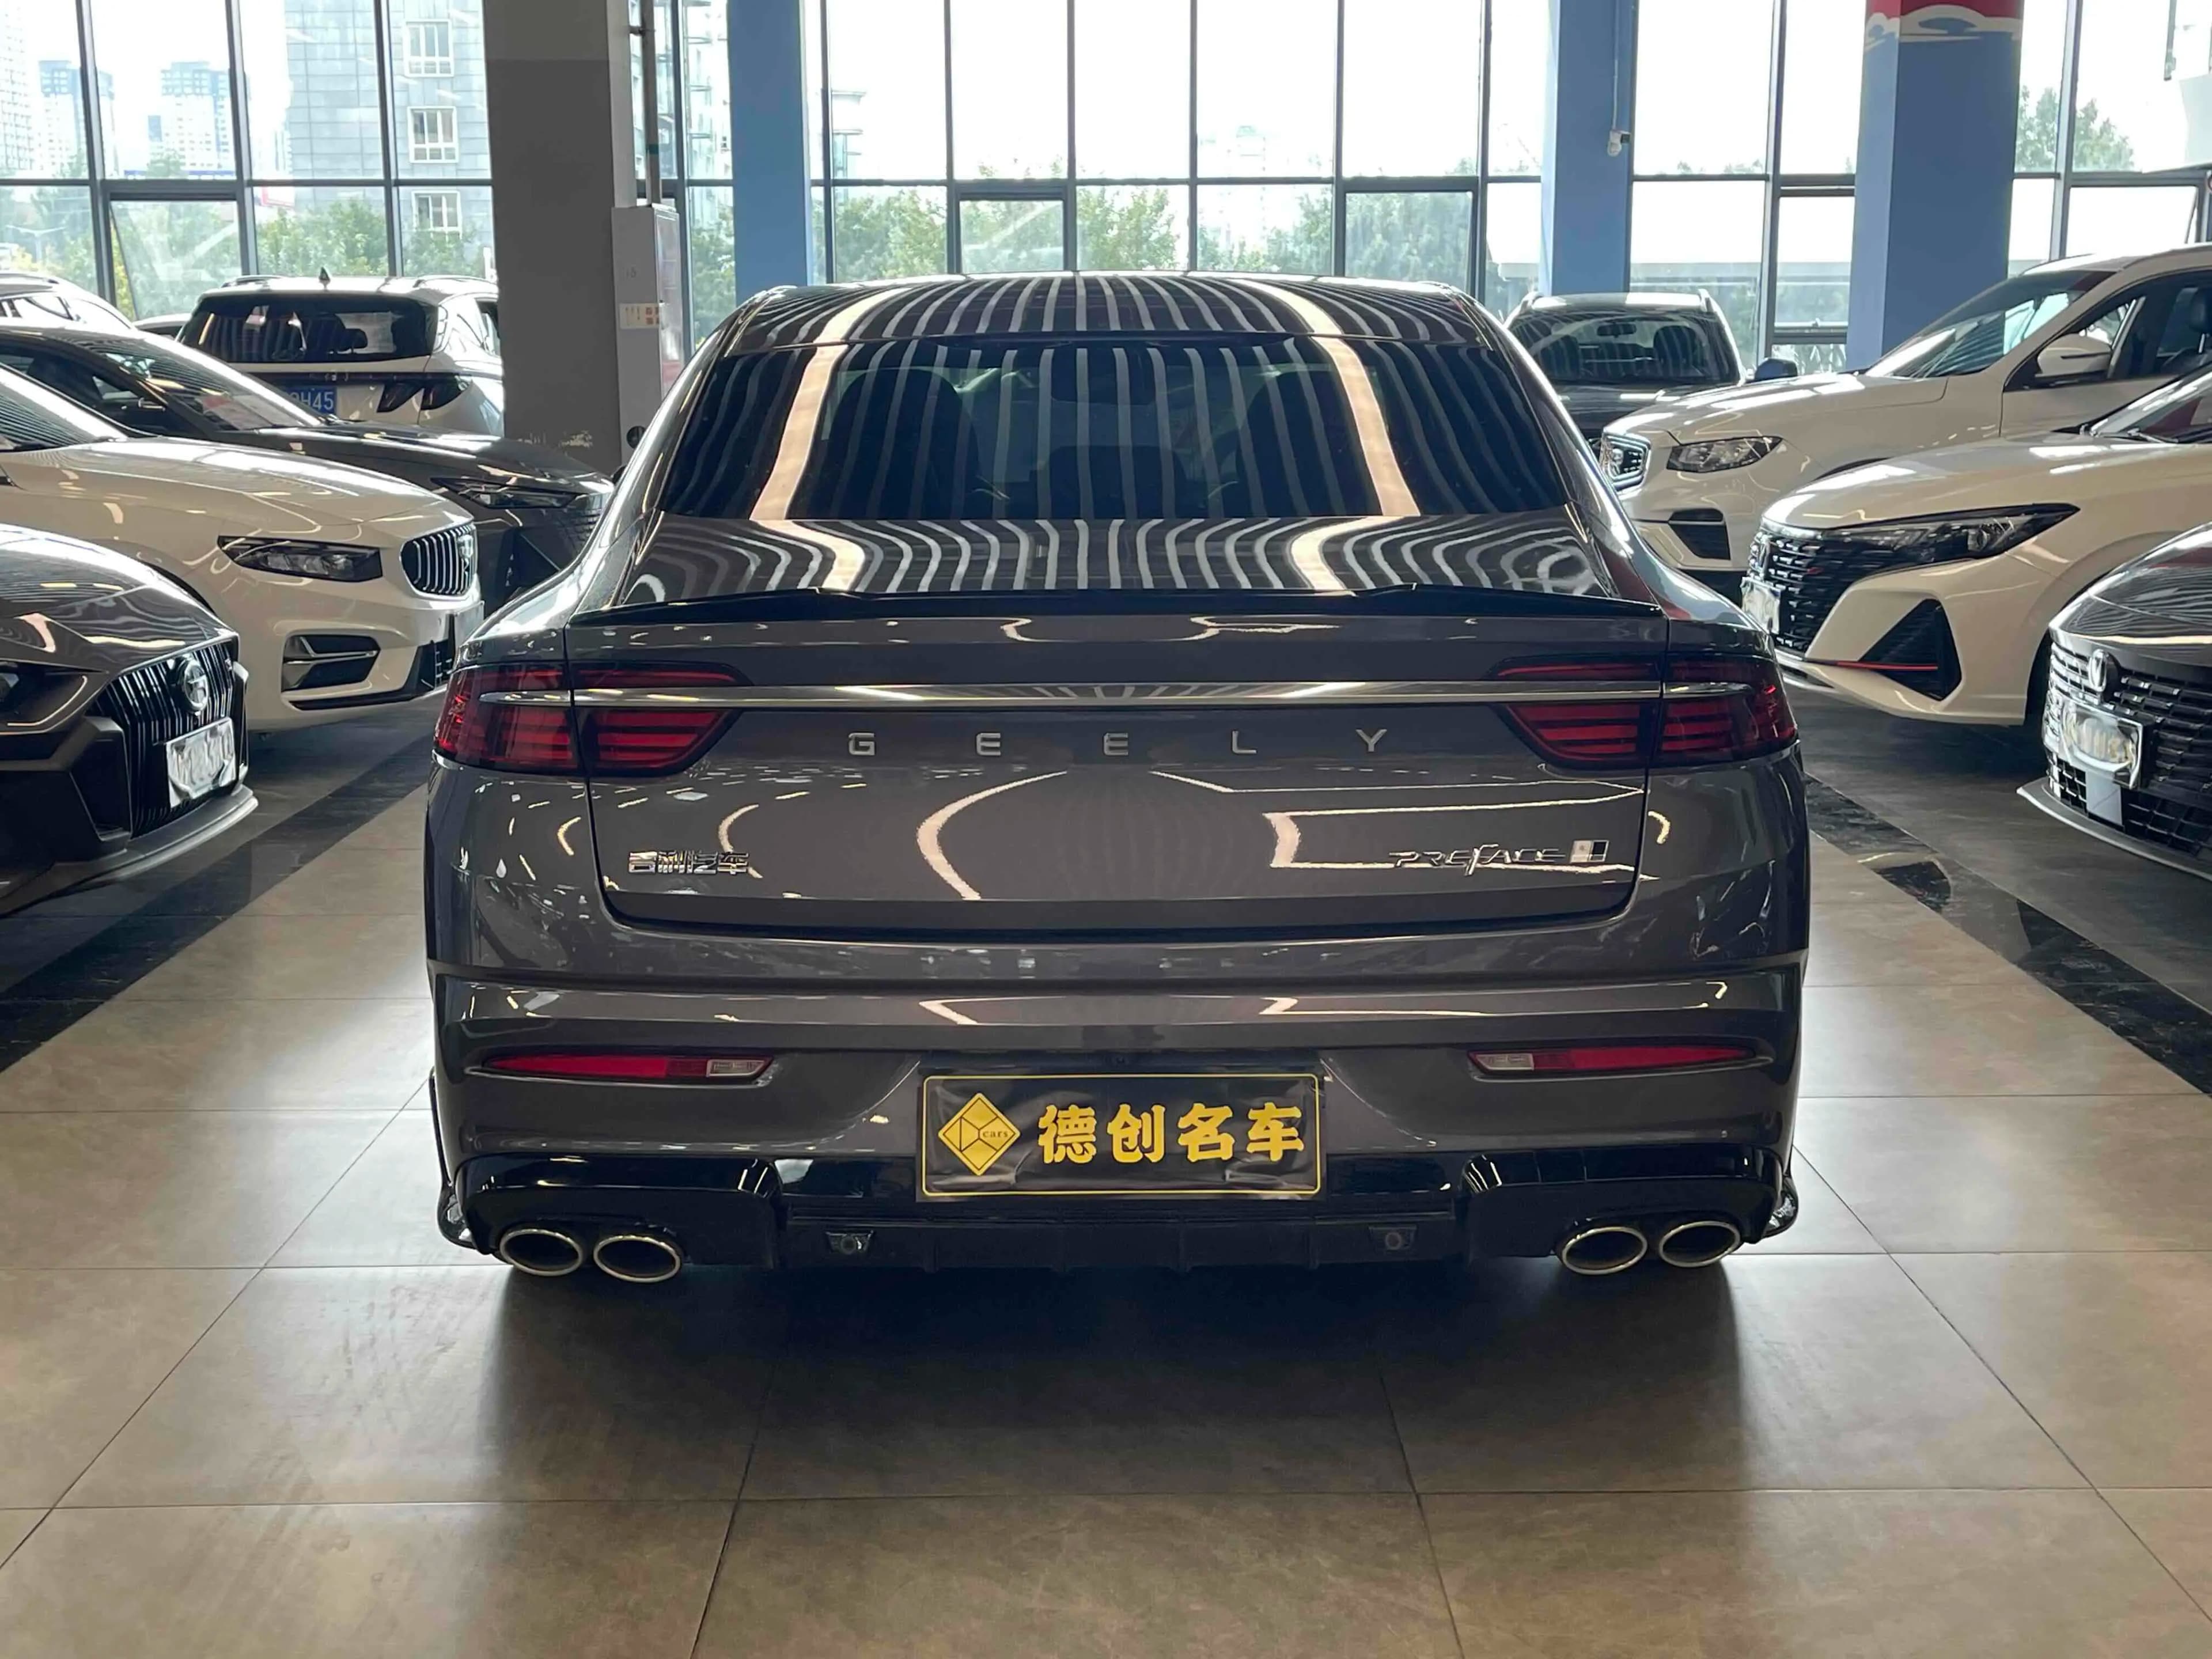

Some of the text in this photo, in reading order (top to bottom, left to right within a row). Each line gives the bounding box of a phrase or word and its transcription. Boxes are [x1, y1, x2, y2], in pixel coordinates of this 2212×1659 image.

[848, 728, 1388, 756] GEELY
[1038, 1103, 1305, 1163] 德创名车
